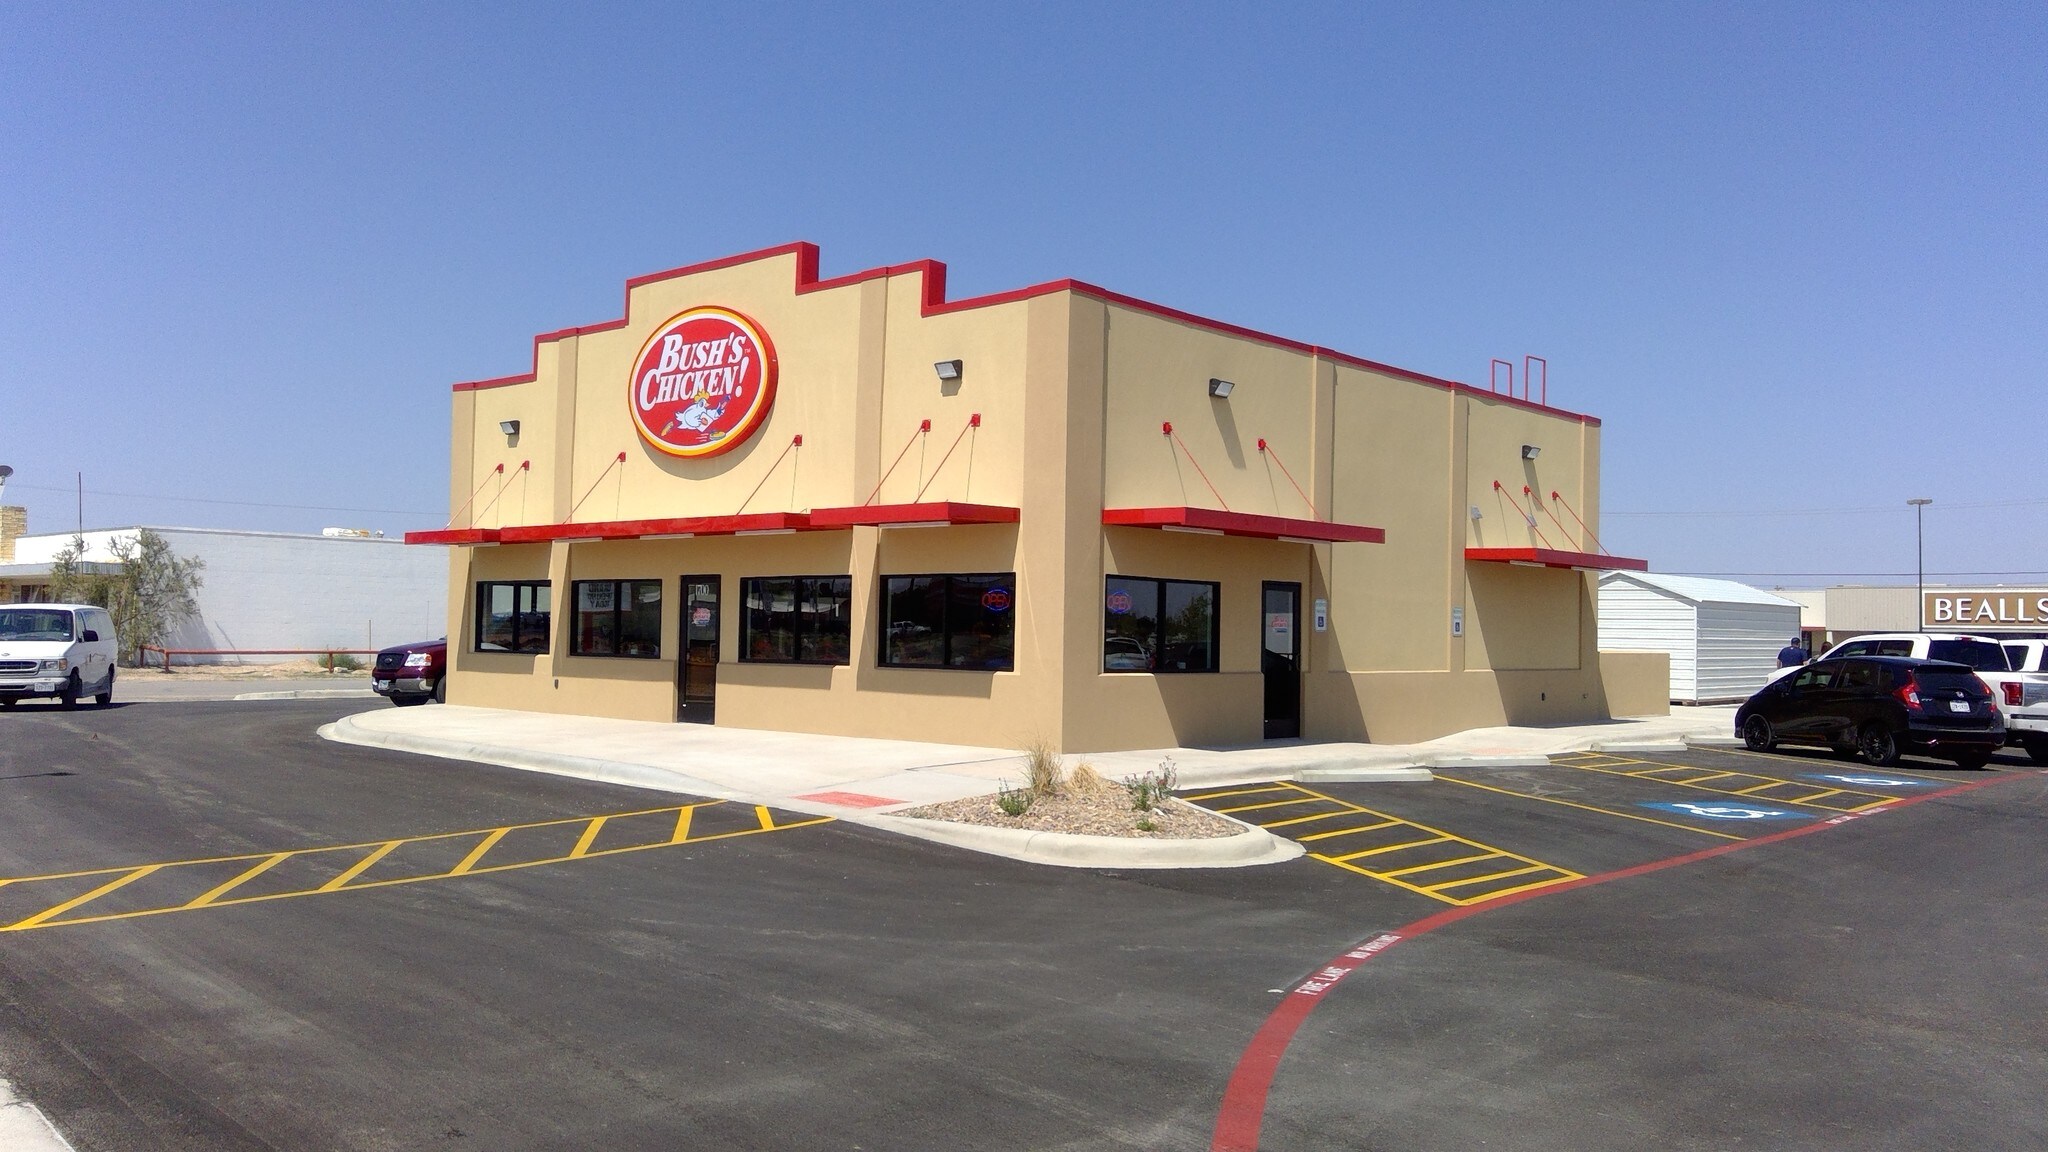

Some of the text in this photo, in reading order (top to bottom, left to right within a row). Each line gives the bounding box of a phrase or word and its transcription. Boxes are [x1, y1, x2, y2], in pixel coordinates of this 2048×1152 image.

[658, 332, 746, 374] BUSH'S
[640, 356, 749, 411] CHICKEN!
[1935, 598, 2048, 622] BEALLS
